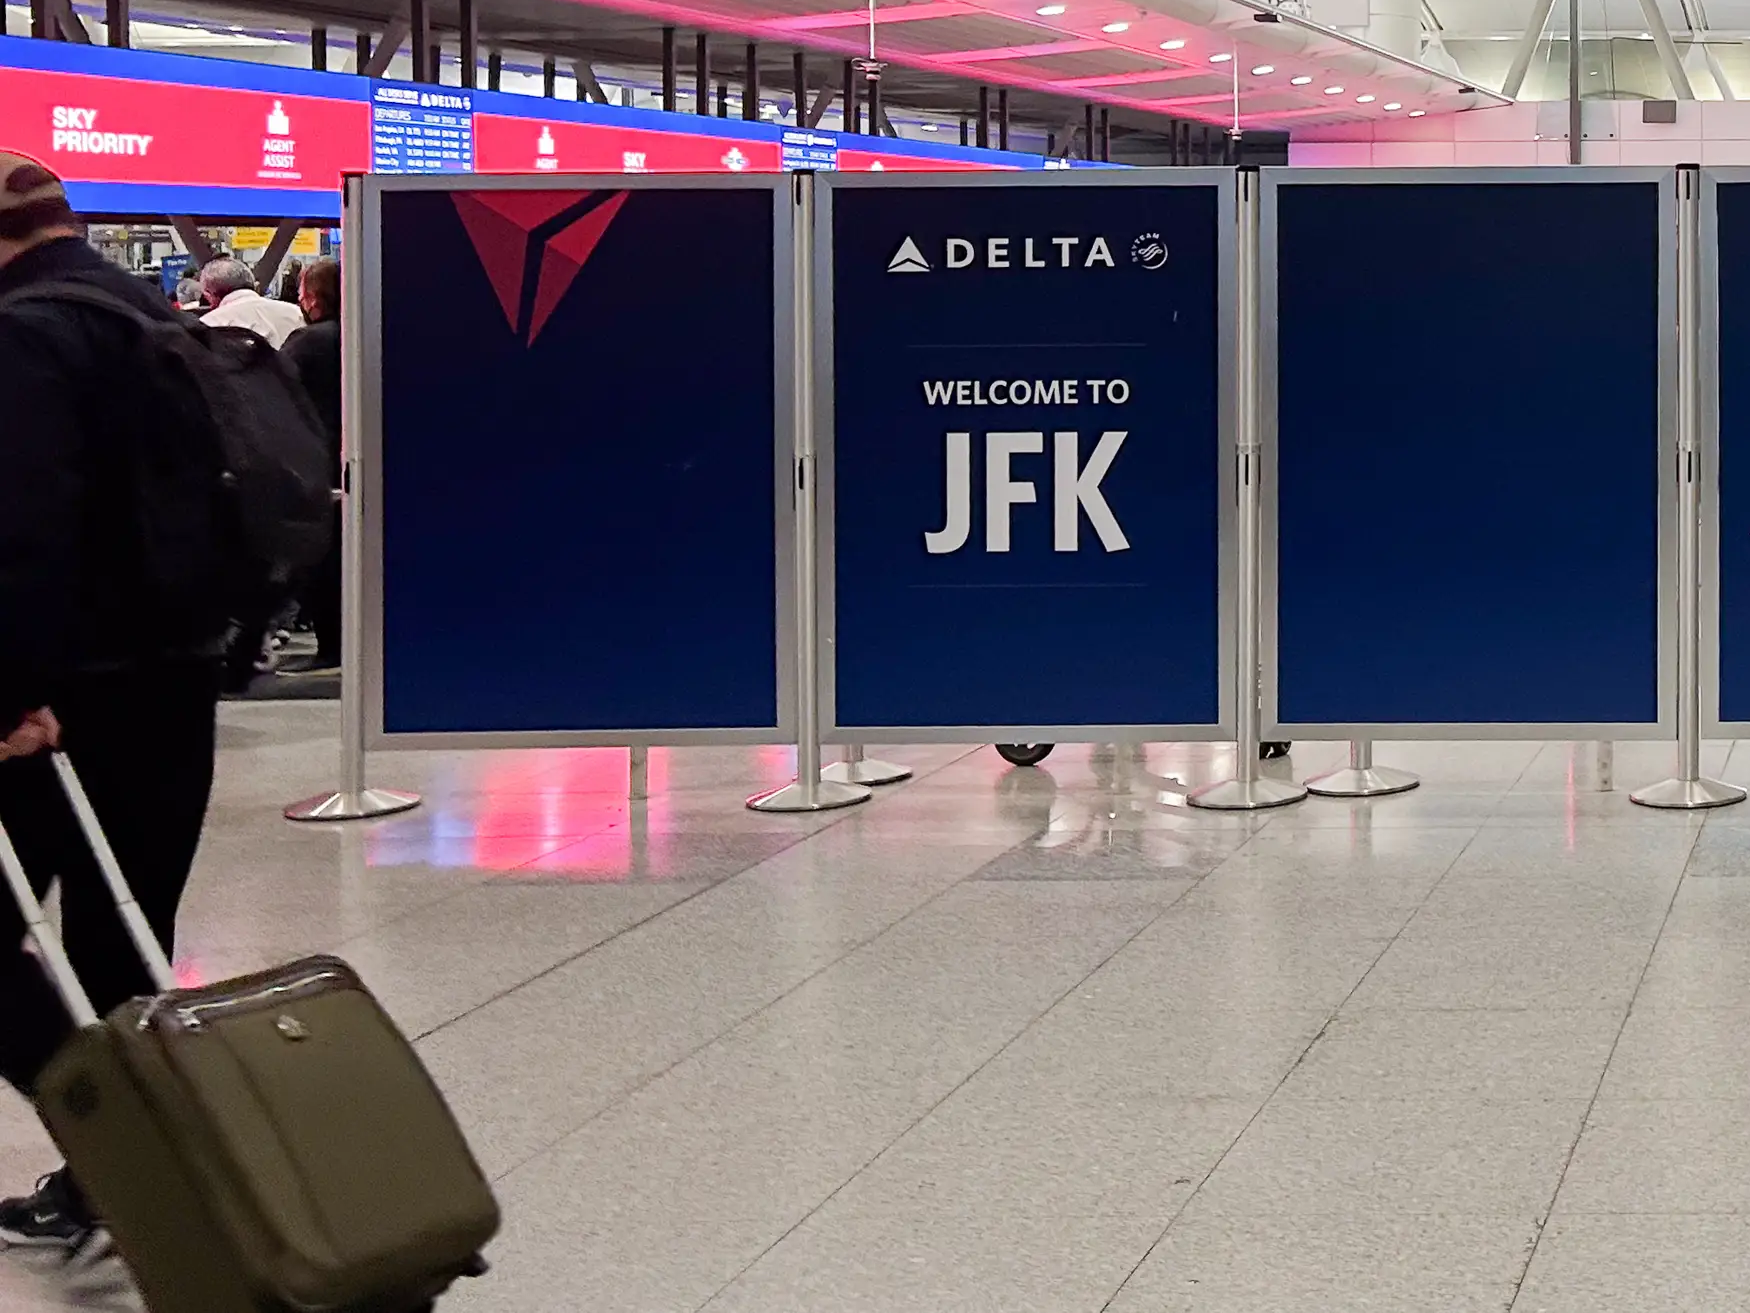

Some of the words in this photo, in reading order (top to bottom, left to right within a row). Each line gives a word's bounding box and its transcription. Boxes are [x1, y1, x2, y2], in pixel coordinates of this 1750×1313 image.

[52, 106, 97, 130] SKY
[52, 130, 153, 156] PRIORITY
[263, 138, 296, 153] AGENT
[263, 154, 296, 168] ASSIST
[623, 151, 646, 167] SKY
[946, 237, 1115, 268] DELTA
[923, 380, 1078, 406] WELCOME
[1086, 379, 1130, 405] TO
[924, 431, 1131, 554] JFK
